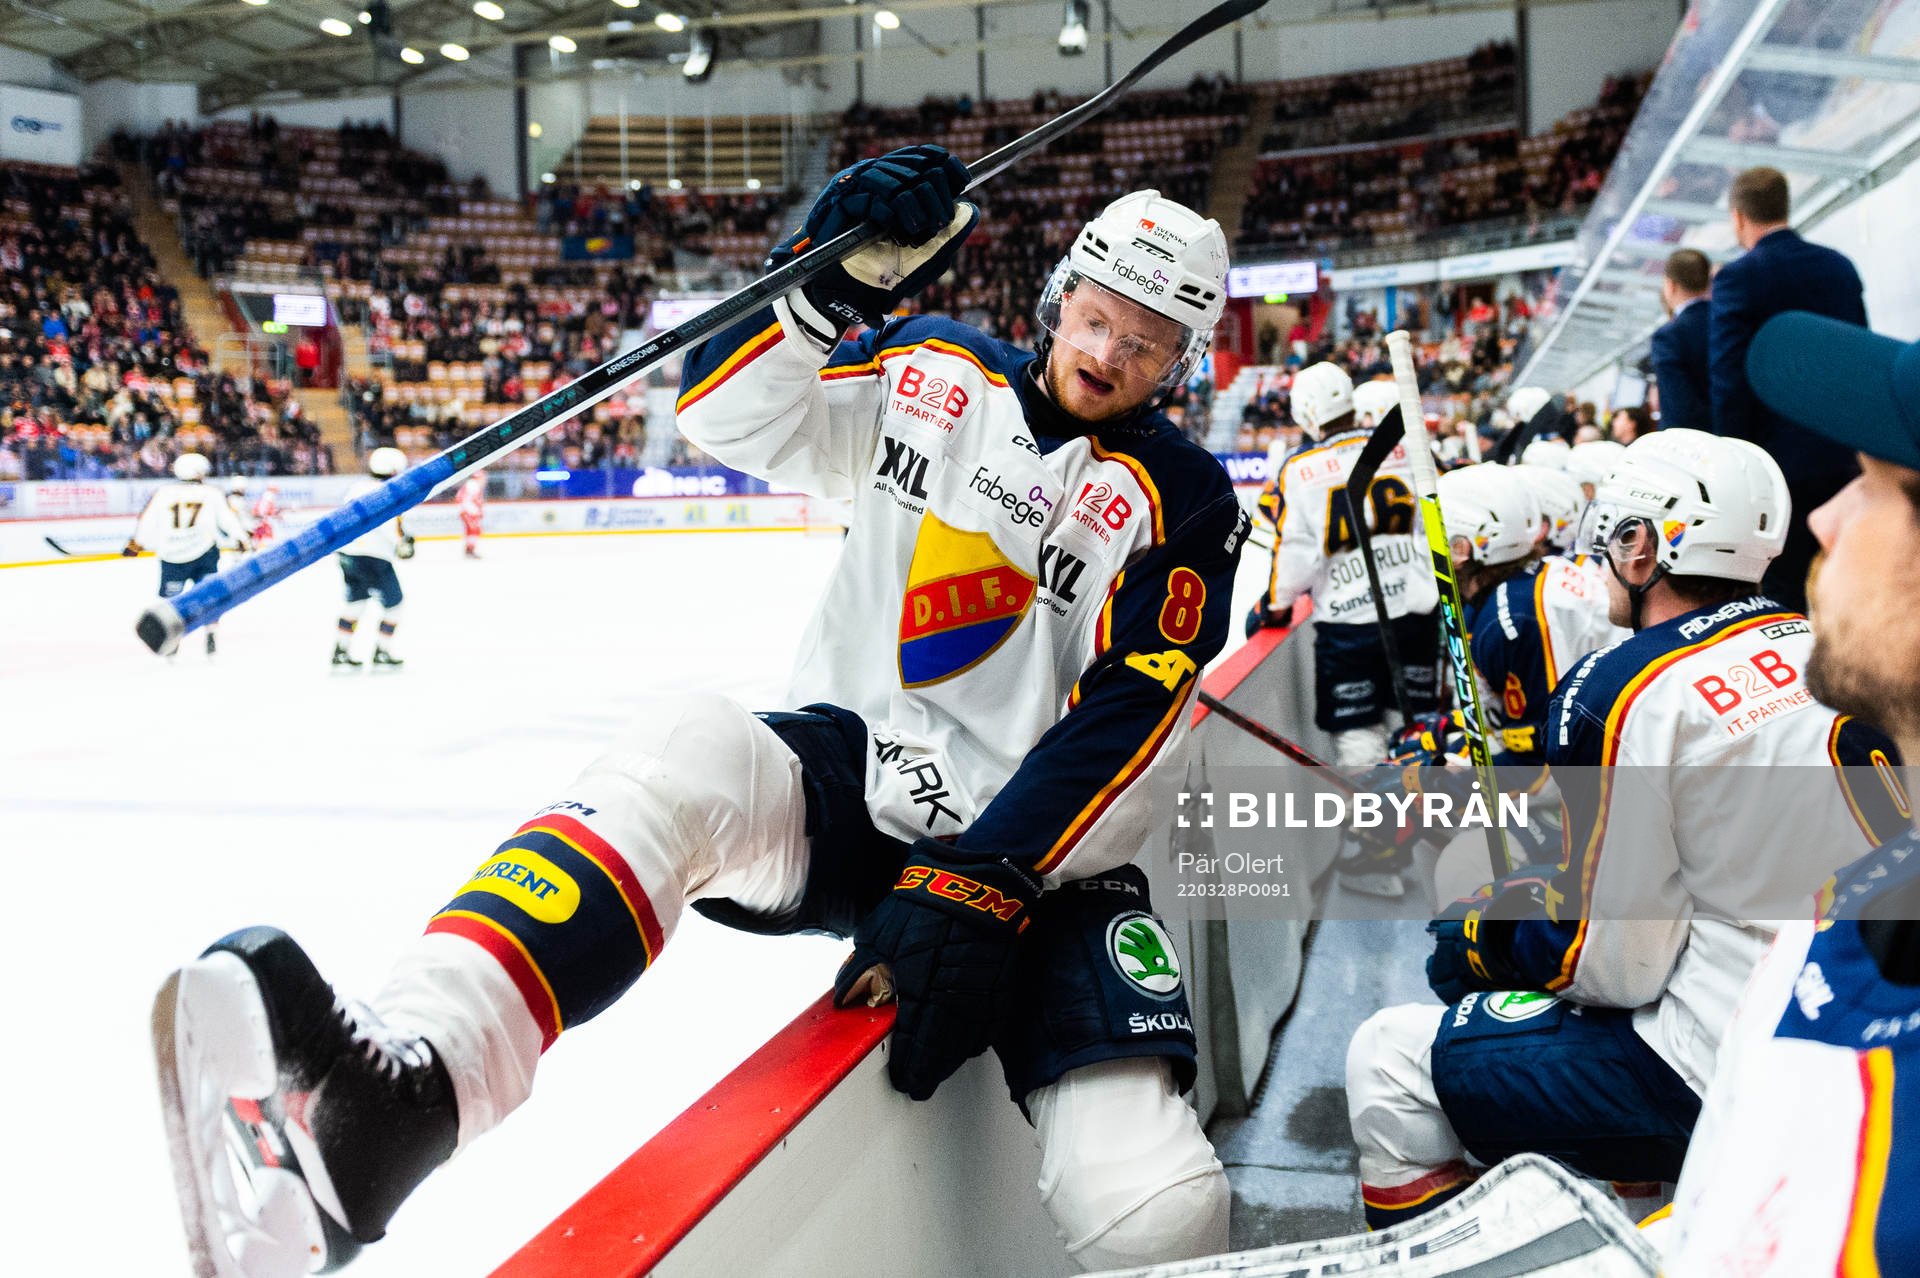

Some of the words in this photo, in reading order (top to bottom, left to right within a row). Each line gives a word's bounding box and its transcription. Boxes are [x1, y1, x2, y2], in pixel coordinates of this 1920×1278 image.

[1131, 240, 1176, 264] CCM
[1156, 225, 1188, 247] SVENSKA
[1112, 258, 1164, 296] Fabege
[606, 343, 659, 376] ARNESSON#8
[896, 365, 969, 419] B2B
[1011, 435, 1043, 460] CC
[876, 436, 930, 501] XXL
[874, 481, 888, 492] All
[969, 466, 1044, 528] Fabege
[1629, 489, 1665, 502] CCM
[168, 502, 203, 529] 17
[1071, 509, 1111, 546] ARTNER
[913, 576, 1017, 628] D.I.F.
[1158, 566, 1206, 645] 8
[1760, 620, 1811, 641] CCM
[1692, 649, 1799, 716] B2B
[894, 866, 1024, 922] CCM
[1079, 879, 1140, 896] CCM
